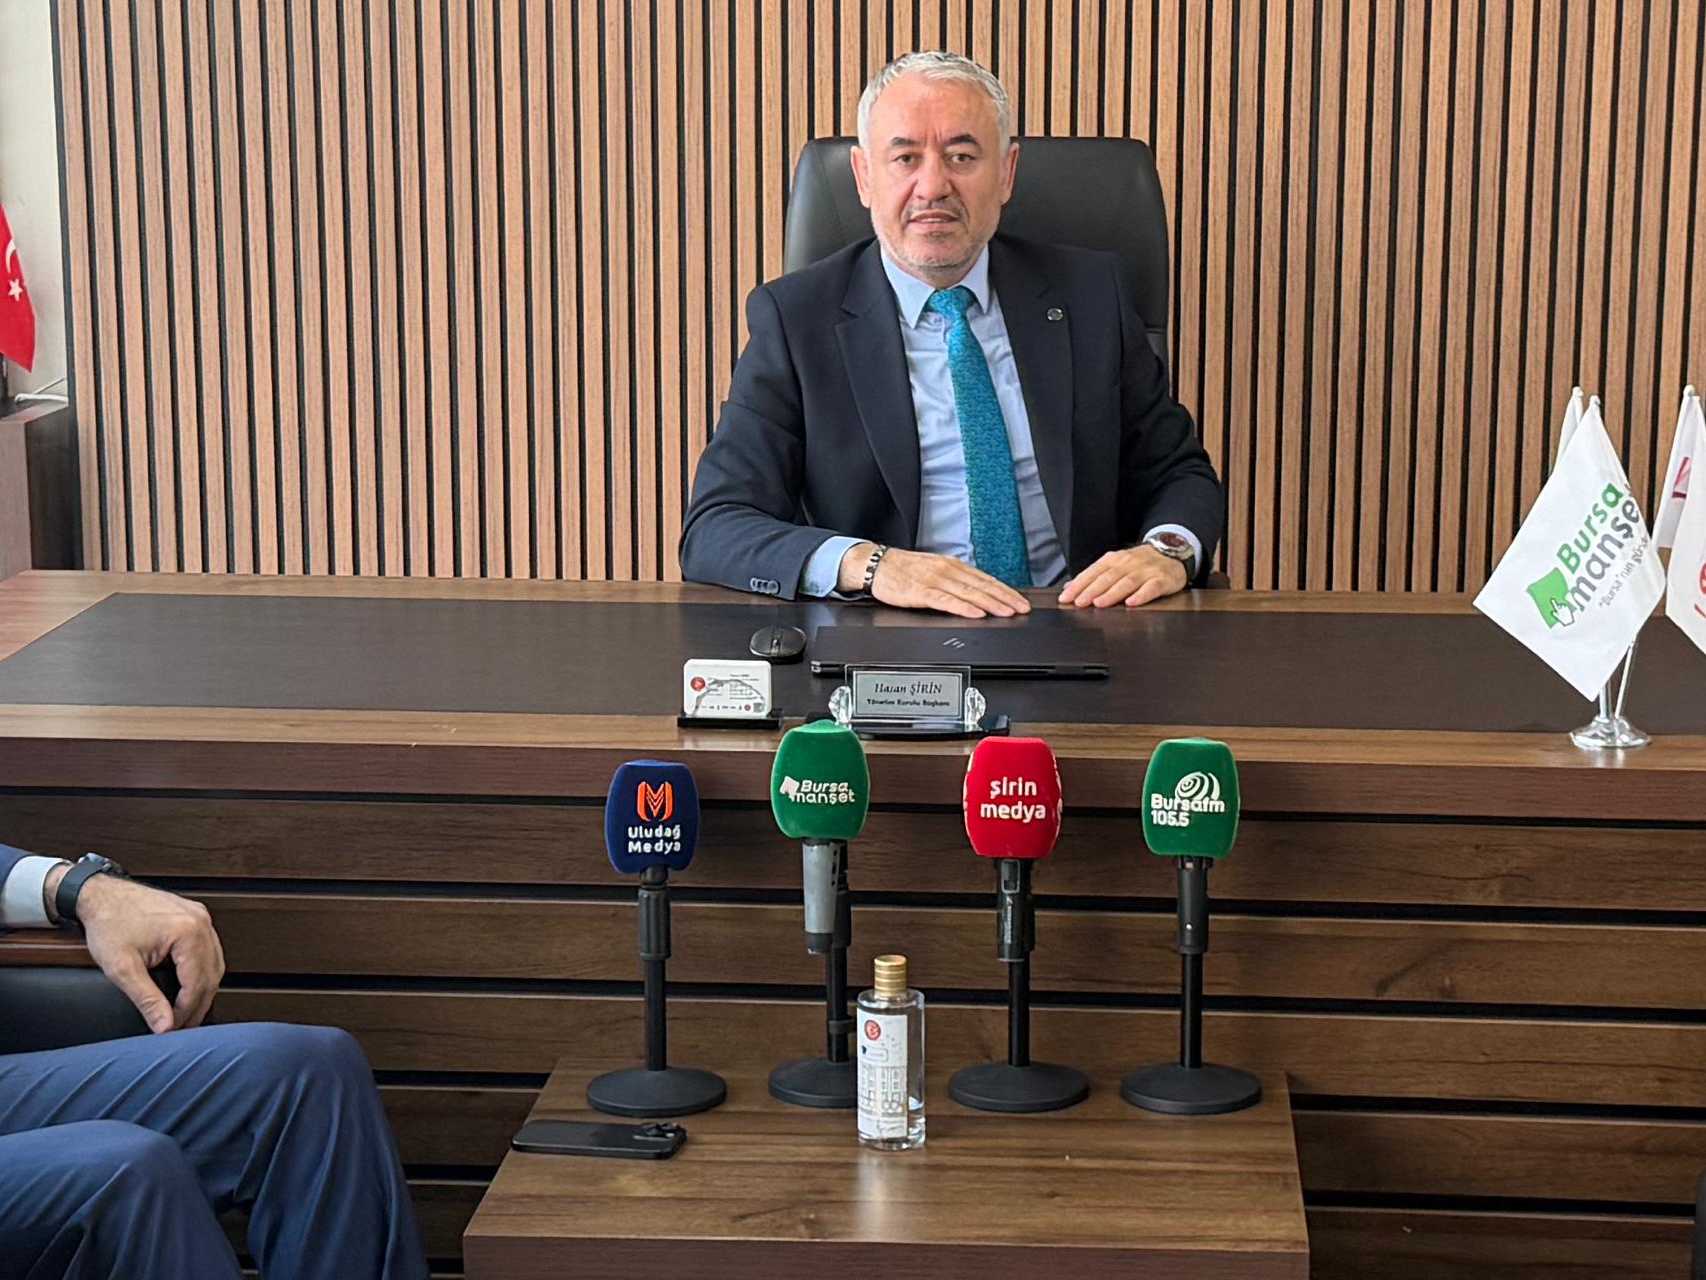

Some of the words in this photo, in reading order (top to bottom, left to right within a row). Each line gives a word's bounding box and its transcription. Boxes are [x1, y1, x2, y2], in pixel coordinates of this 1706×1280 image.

[1556, 481, 1624, 576] Bursa
[1570, 483, 1640, 613] manşe
[874, 682, 907, 694] Hasan
[909, 680, 943, 696] ŞİRİN
[800, 779, 849, 793] Bursa
[989, 775, 1038, 800] şirin
[790, 789, 857, 806] manşet
[979, 799, 1047, 824] medya
[1150, 809, 1190, 828] 105.5
[627, 824, 682, 840] Uludağ
[627, 839, 682, 855] Medya
